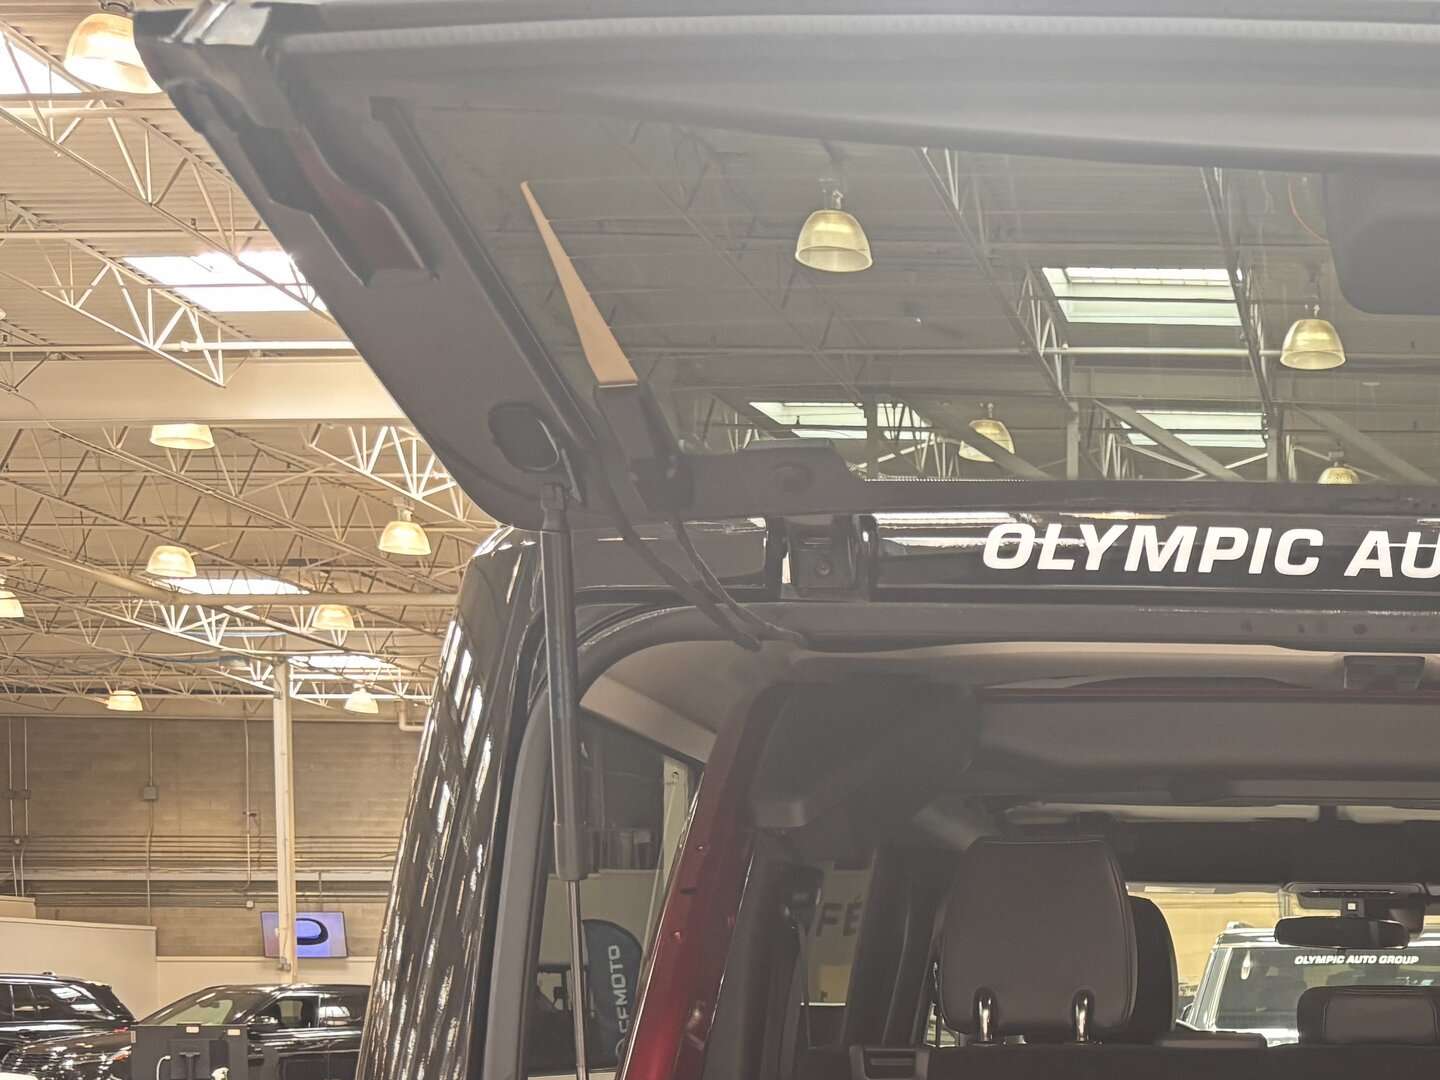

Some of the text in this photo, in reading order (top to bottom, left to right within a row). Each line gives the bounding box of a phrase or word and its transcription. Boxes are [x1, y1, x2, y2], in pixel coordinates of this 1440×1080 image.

[982, 523, 1324, 576] OLYMPIC
[1294, 955, 1419, 965] OLYMPIC AUTO GROUP
[608, 944, 630, 1034] CFMOTO
